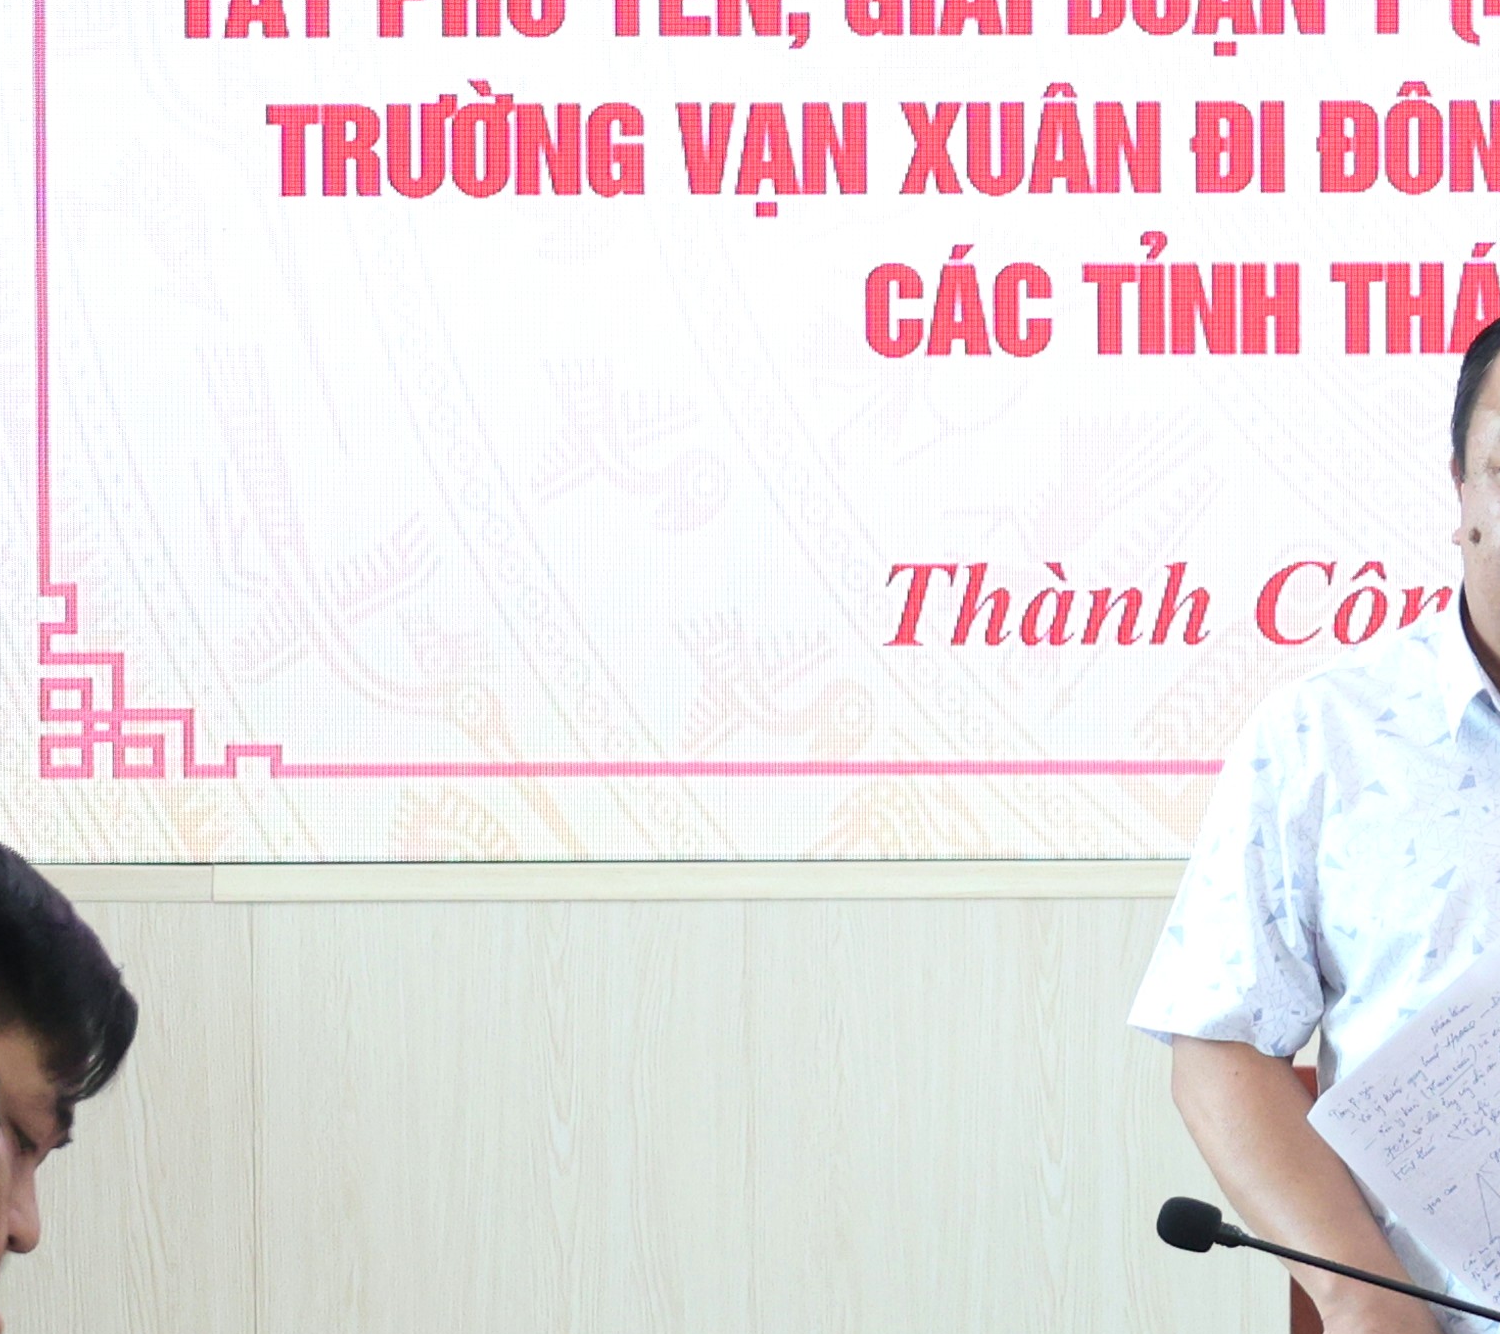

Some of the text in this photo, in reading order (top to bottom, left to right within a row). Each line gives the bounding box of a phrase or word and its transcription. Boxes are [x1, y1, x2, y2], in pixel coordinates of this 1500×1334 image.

[267, 80, 644, 199] TRƯỜNG
[677, 102, 867, 217] VẠN
[902, 83, 1161, 196] XUÂN
[1191, 101, 1285, 193] ĐI
[865, 244, 1052, 358] CÁC
[1083, 231, 1300, 355] TỈNH
[890, 562, 1209, 646] Thành
[1255, 561, 1452, 645] Côn
